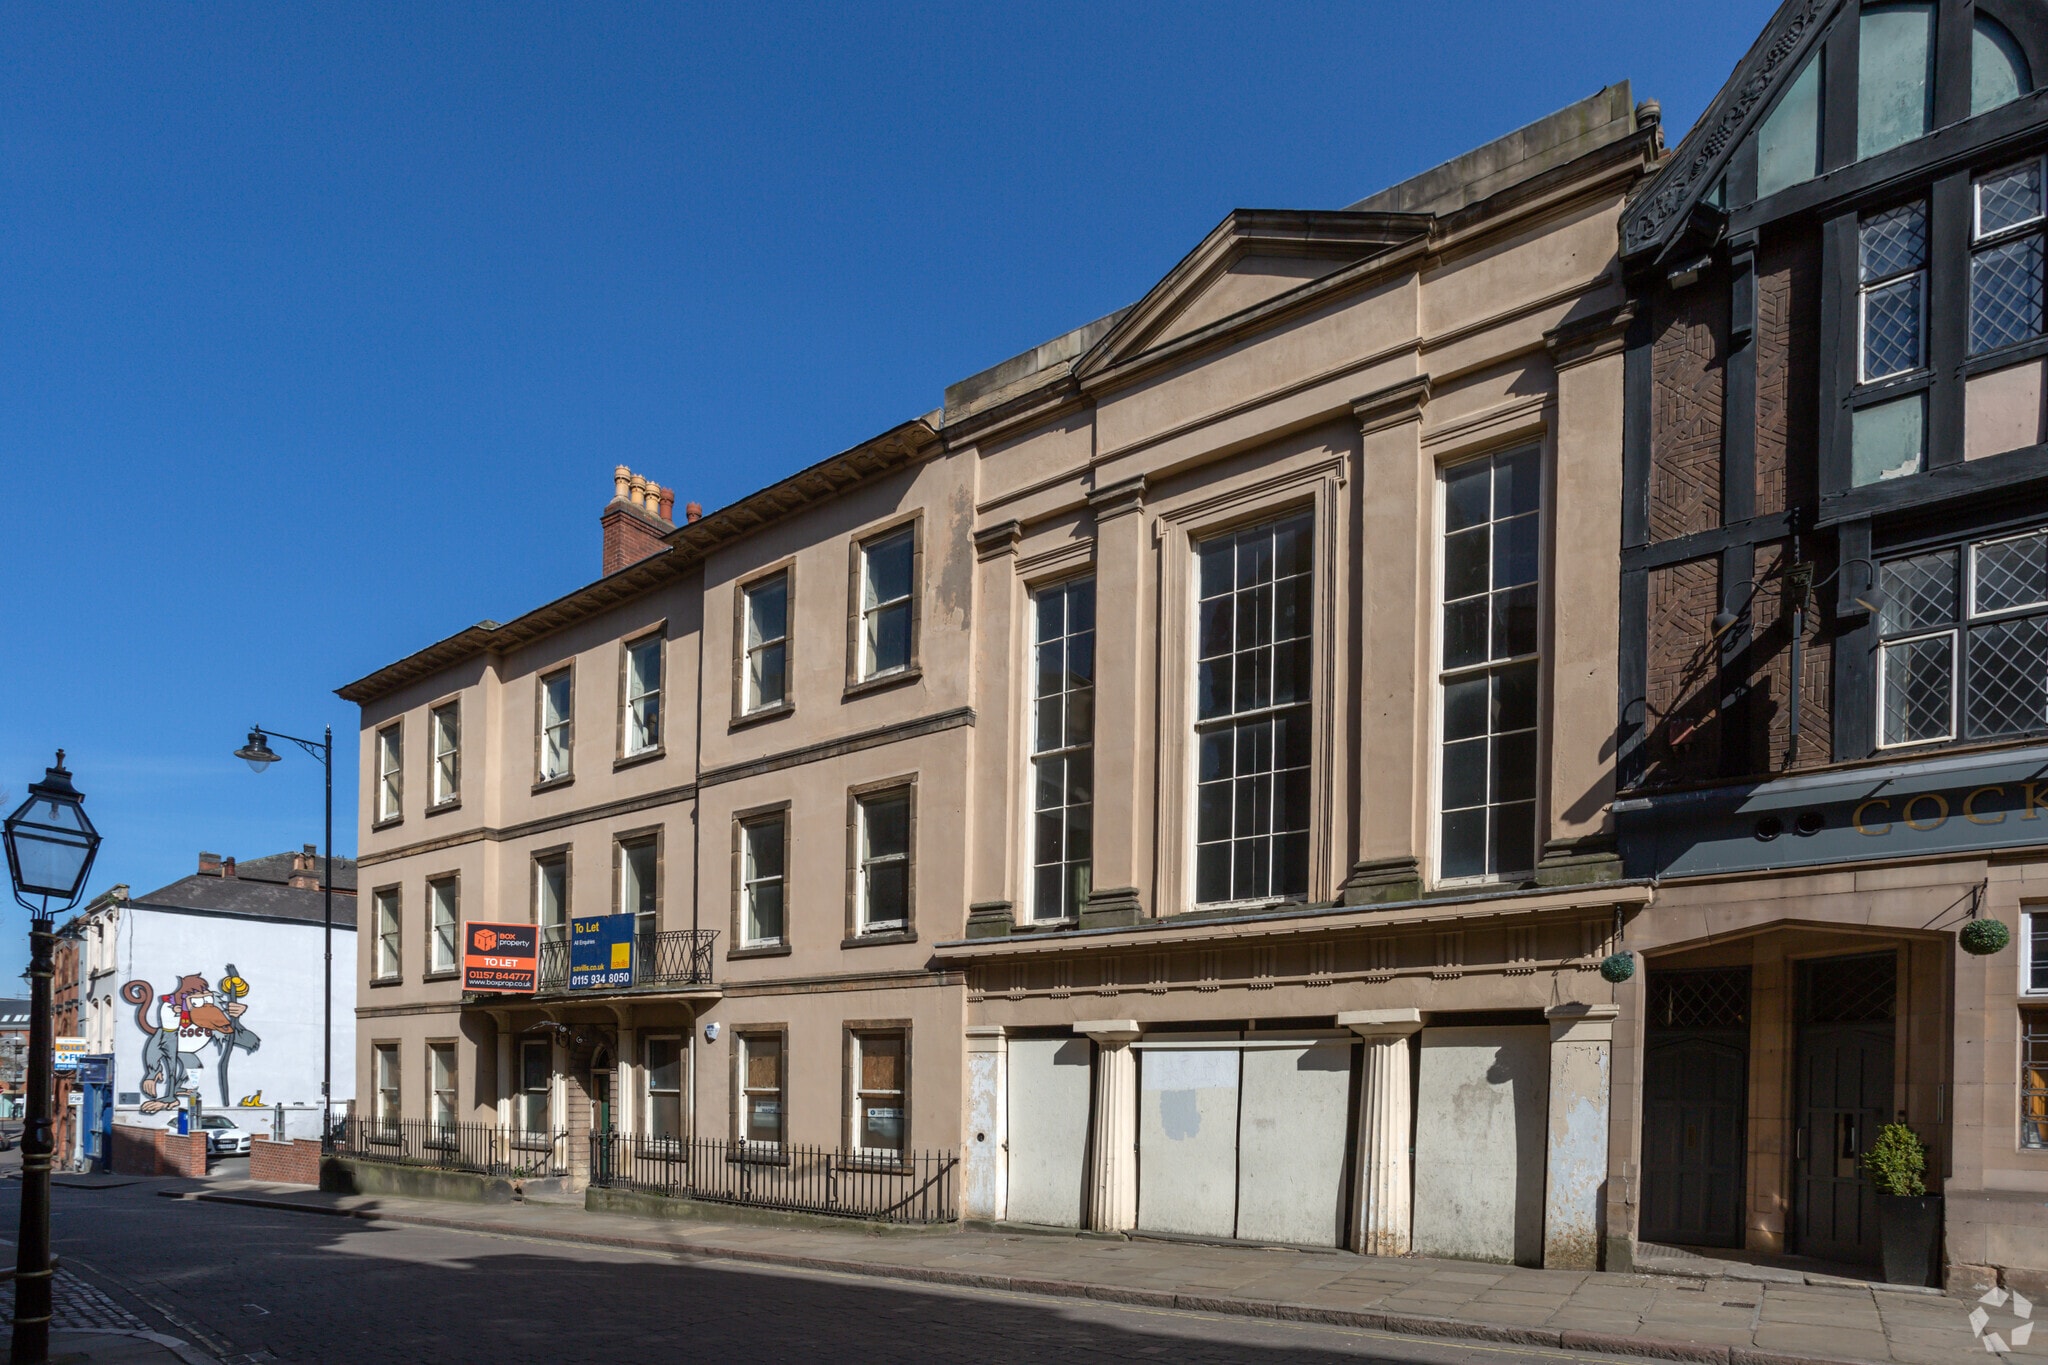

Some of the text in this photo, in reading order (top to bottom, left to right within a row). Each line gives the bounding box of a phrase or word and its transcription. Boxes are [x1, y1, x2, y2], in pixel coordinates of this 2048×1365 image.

[574, 921, 600, 934] To Let
[484, 957, 518, 968] TO LET
[572, 964, 604, 972] savills.co.uk
[469, 970, 532, 981] 01157 844777
[572, 972, 630, 986] 0115 934 8050
